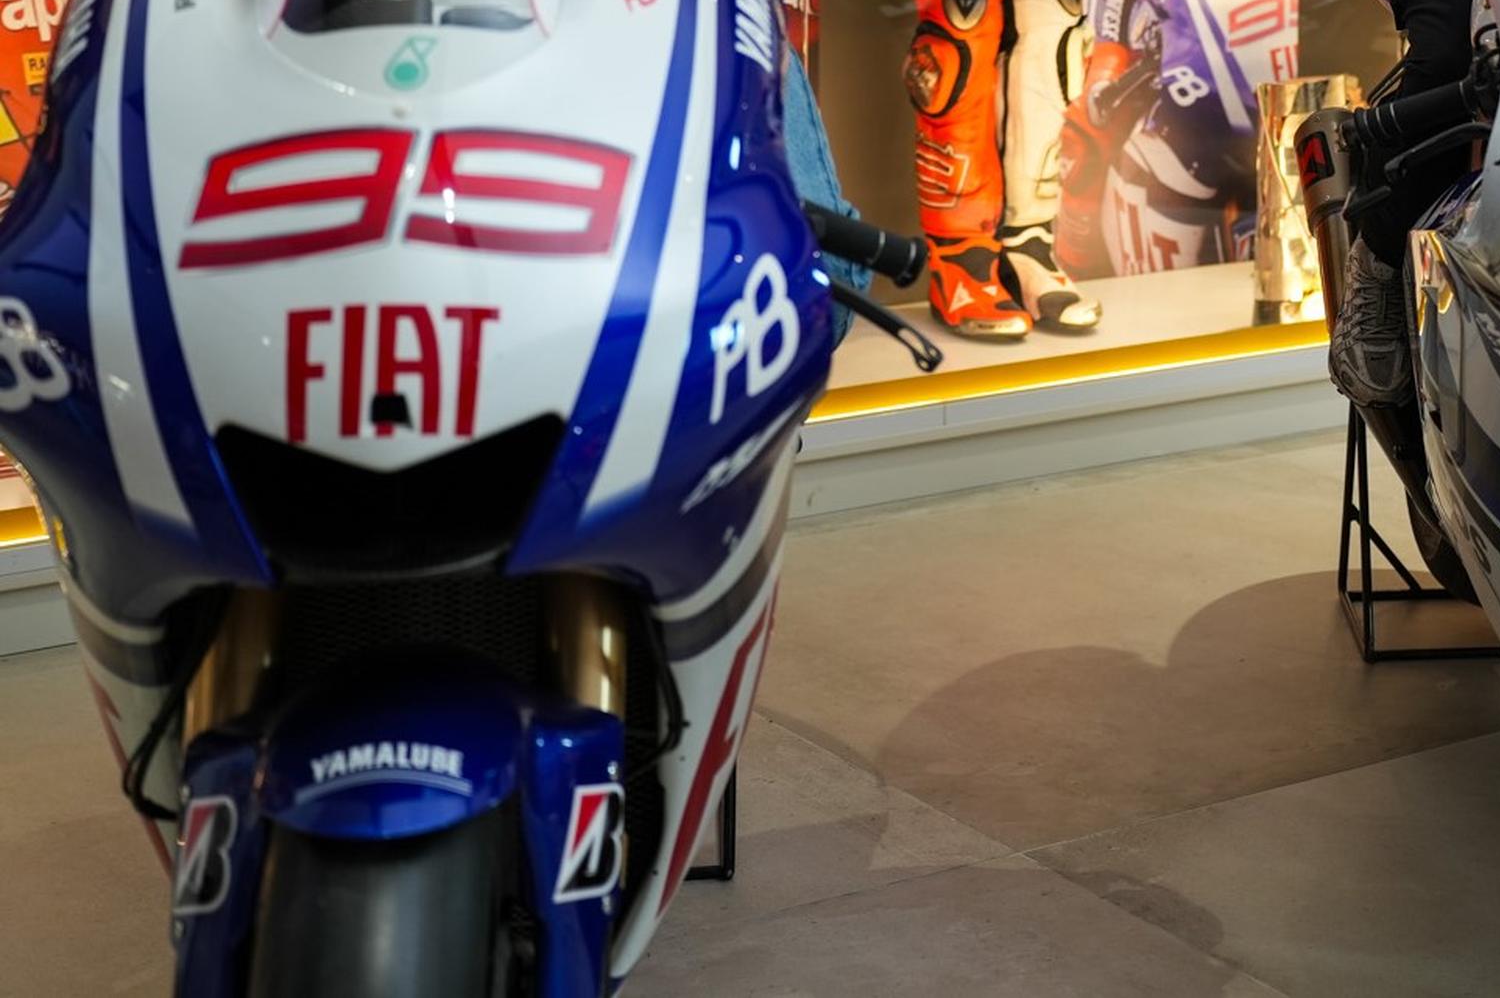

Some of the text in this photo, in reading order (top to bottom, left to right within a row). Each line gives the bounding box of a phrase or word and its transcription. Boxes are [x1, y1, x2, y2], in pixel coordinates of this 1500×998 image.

[178, 125, 635, 270] 99
[285, 304, 501, 444] FIAT
[311, 741, 464, 783] YAMALUBE
